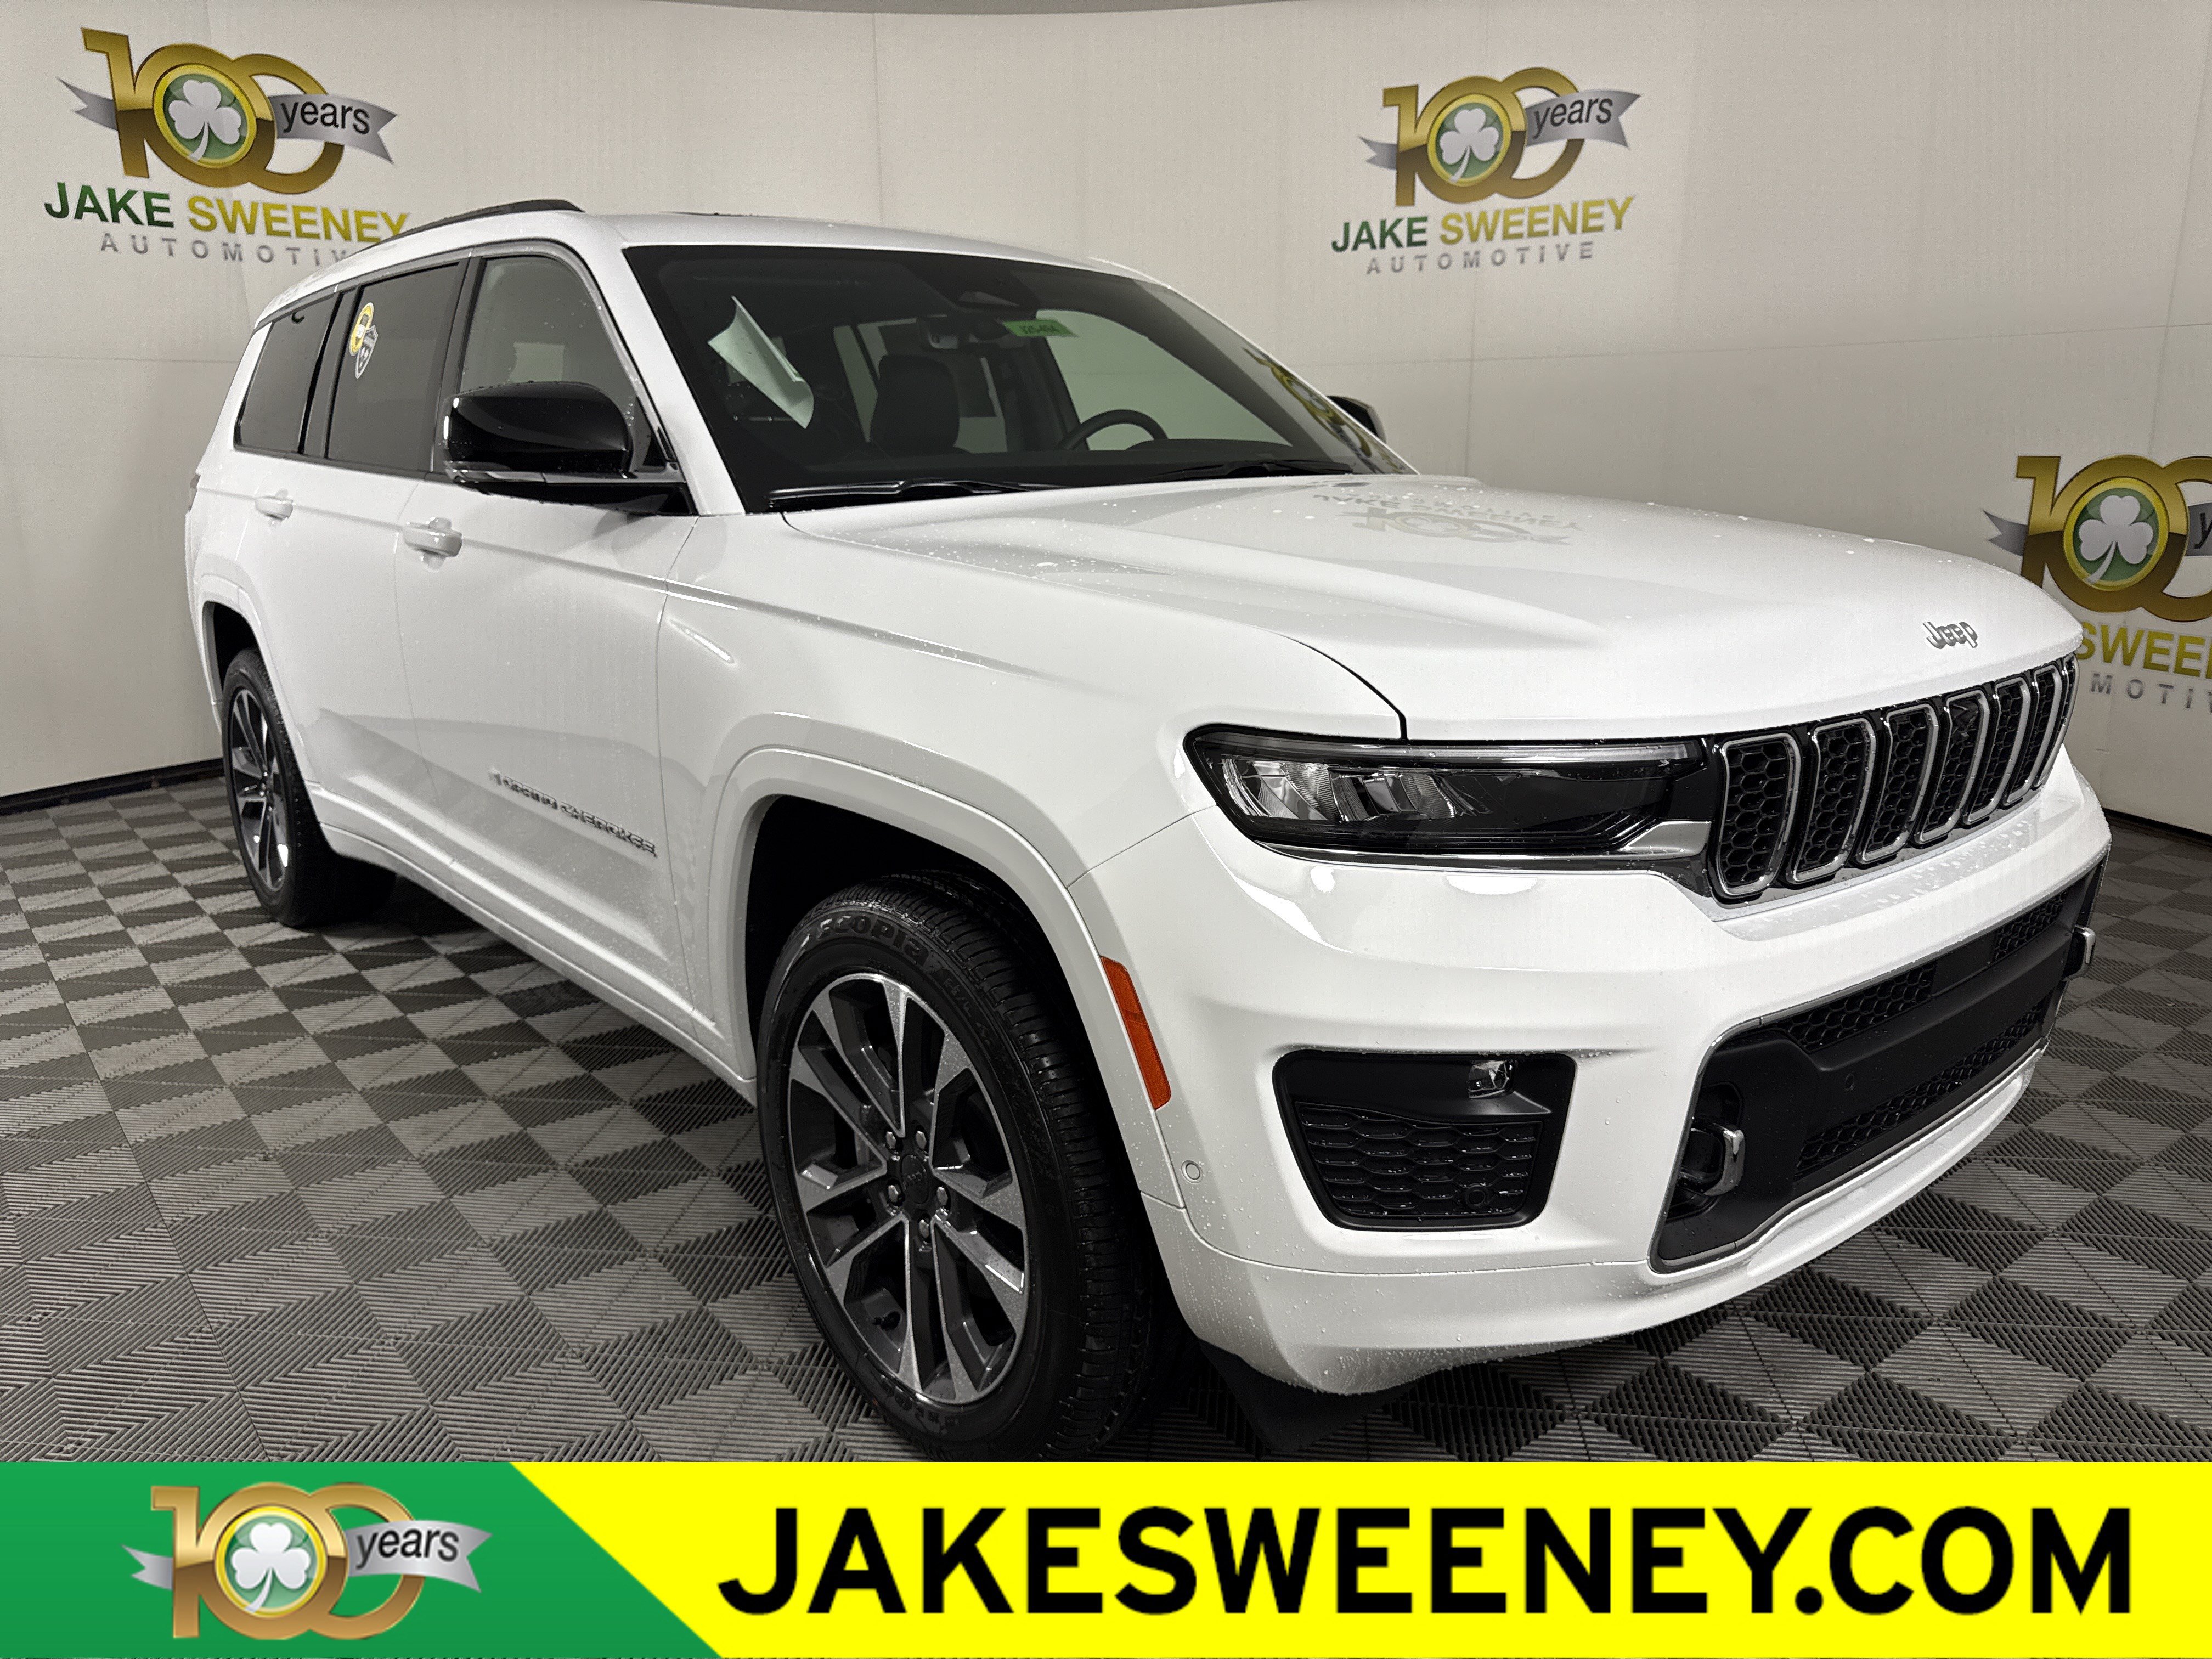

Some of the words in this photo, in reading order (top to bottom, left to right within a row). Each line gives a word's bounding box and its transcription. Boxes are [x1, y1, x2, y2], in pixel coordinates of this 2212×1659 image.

[81, 27, 344, 195] 100
[280, 98, 371, 136] years
[1533, 97, 1614, 139] years
[1383, 67, 1585, 207] 100
[44, 182, 174, 228] JAKE
[188, 196, 408, 243] SWEENEY
[1331, 216, 1429, 253] JAKE
[1440, 196, 1634, 245] SWEENEY
[100, 232, 347, 267] AUTOMOTIV
[1367, 241, 1594, 275] AUTOMOTIVE
[1922, 621, 1978, 649] Jeep
[2076, 622, 2212, 679] SWEE
